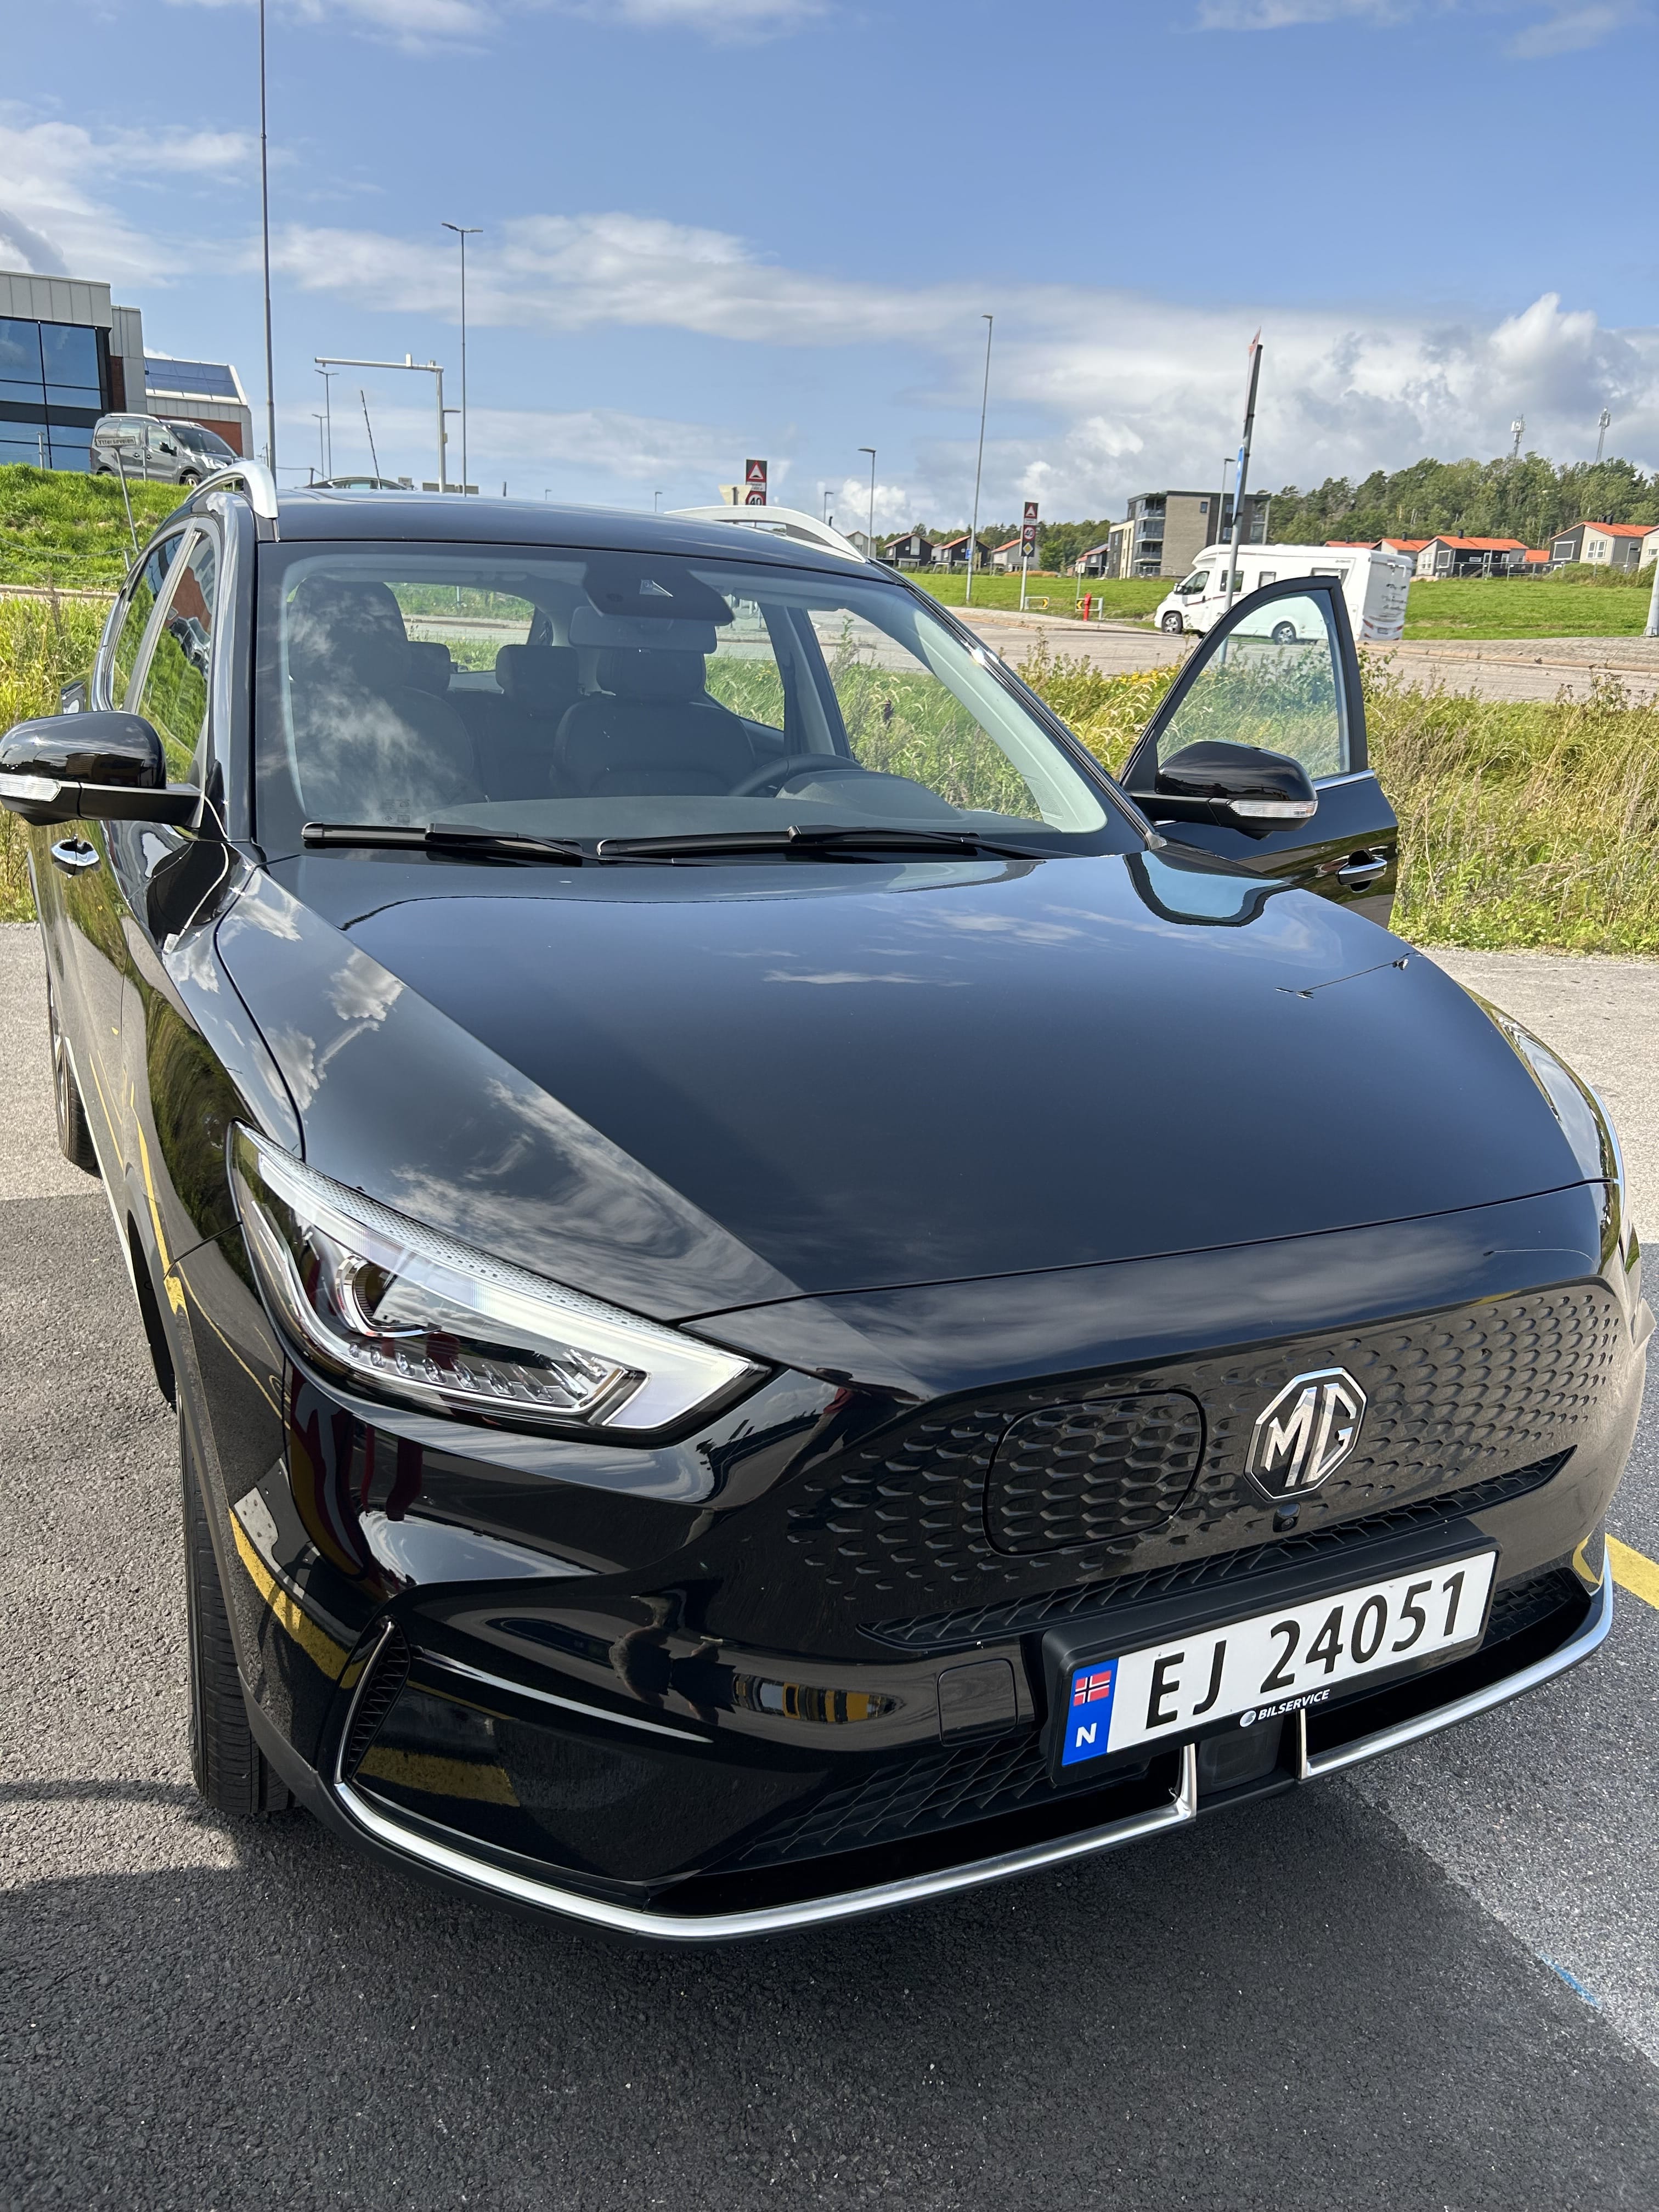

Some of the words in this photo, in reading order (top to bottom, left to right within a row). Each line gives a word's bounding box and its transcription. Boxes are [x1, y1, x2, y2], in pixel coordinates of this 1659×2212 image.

[750, 496, 762, 505] 40
[1260, 1383, 1357, 1487] MG
[1146, 1639, 1227, 1729] EJ
[1260, 1571, 1465, 1694] 24051
[1258, 1689, 1330, 1720] BILSERVICE
[1075, 1722, 1097, 1748] N
